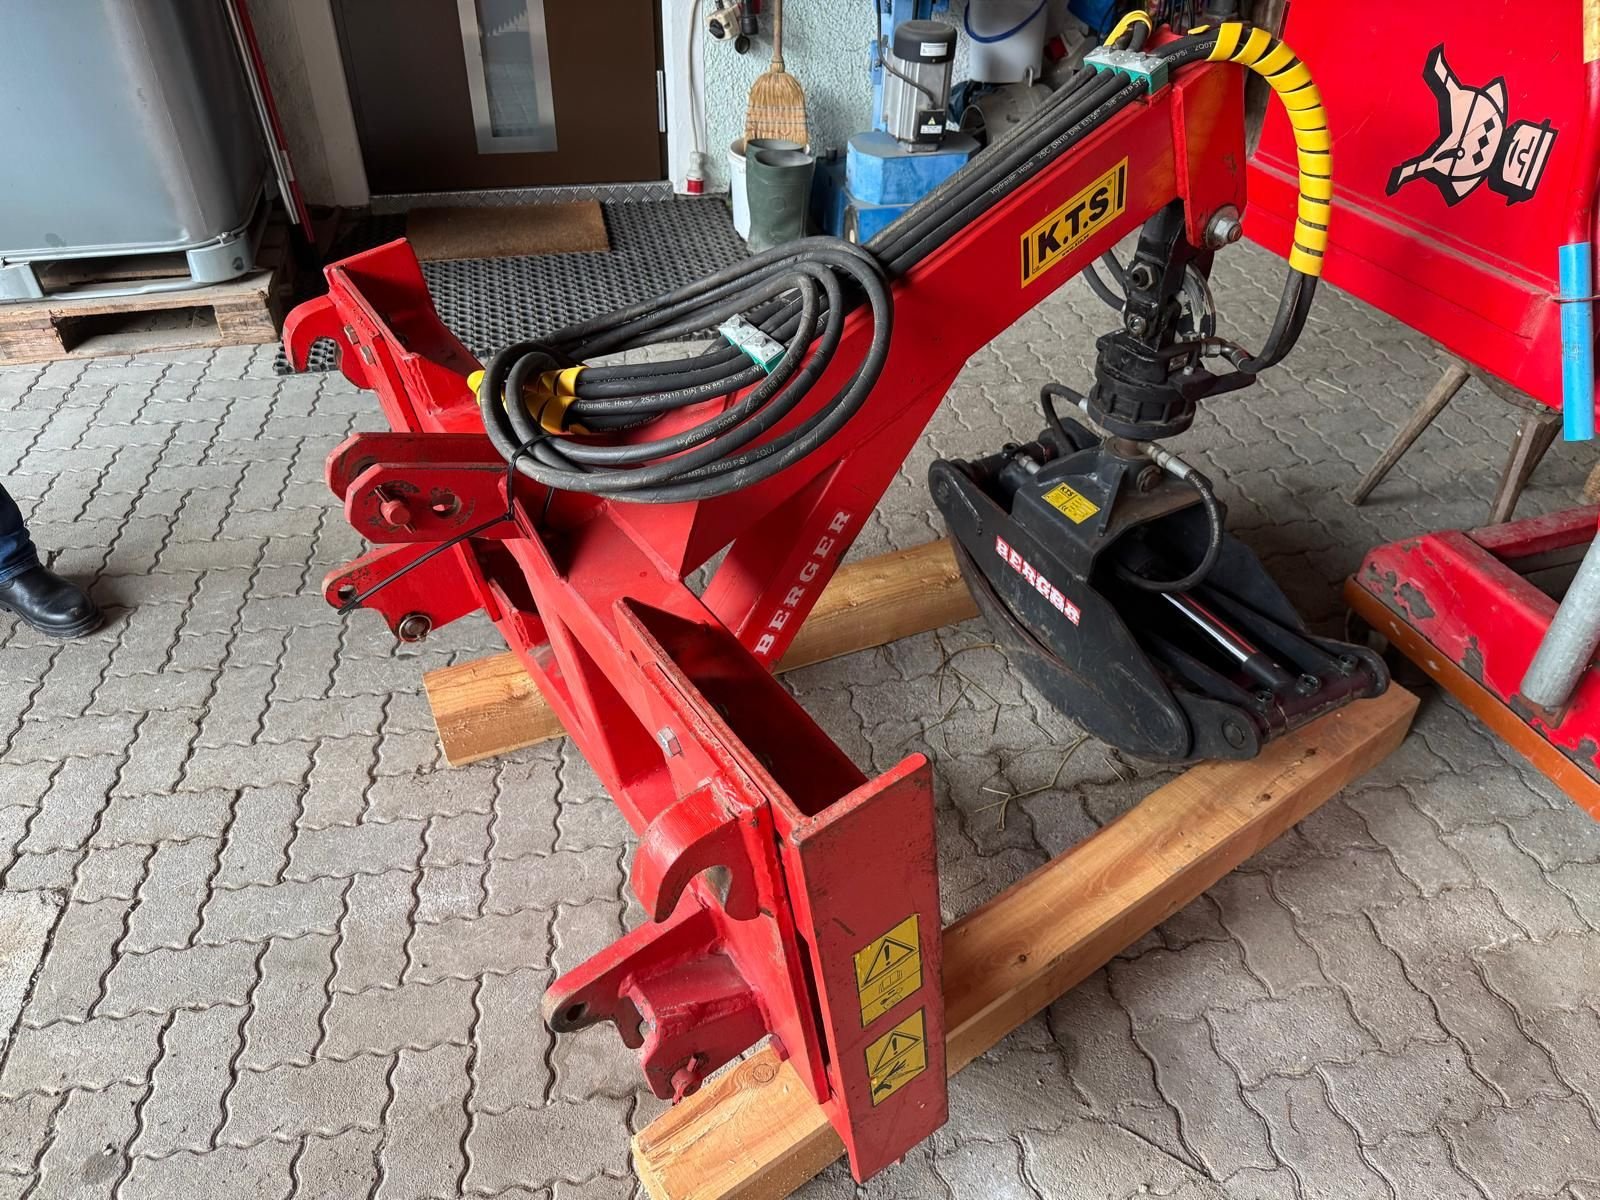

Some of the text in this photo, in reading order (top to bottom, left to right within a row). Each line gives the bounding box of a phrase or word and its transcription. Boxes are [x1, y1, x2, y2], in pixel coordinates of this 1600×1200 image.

[614, 399, 633, 408] Hose
[641, 395, 656, 404] 2SC
[659, 391, 680, 401] DN10
[683, 386, 698, 397] DIN
[700, 384, 711, 393] EN
[753, 510, 850, 656] BERGER
[995, 535, 1081, 627] BERGER
